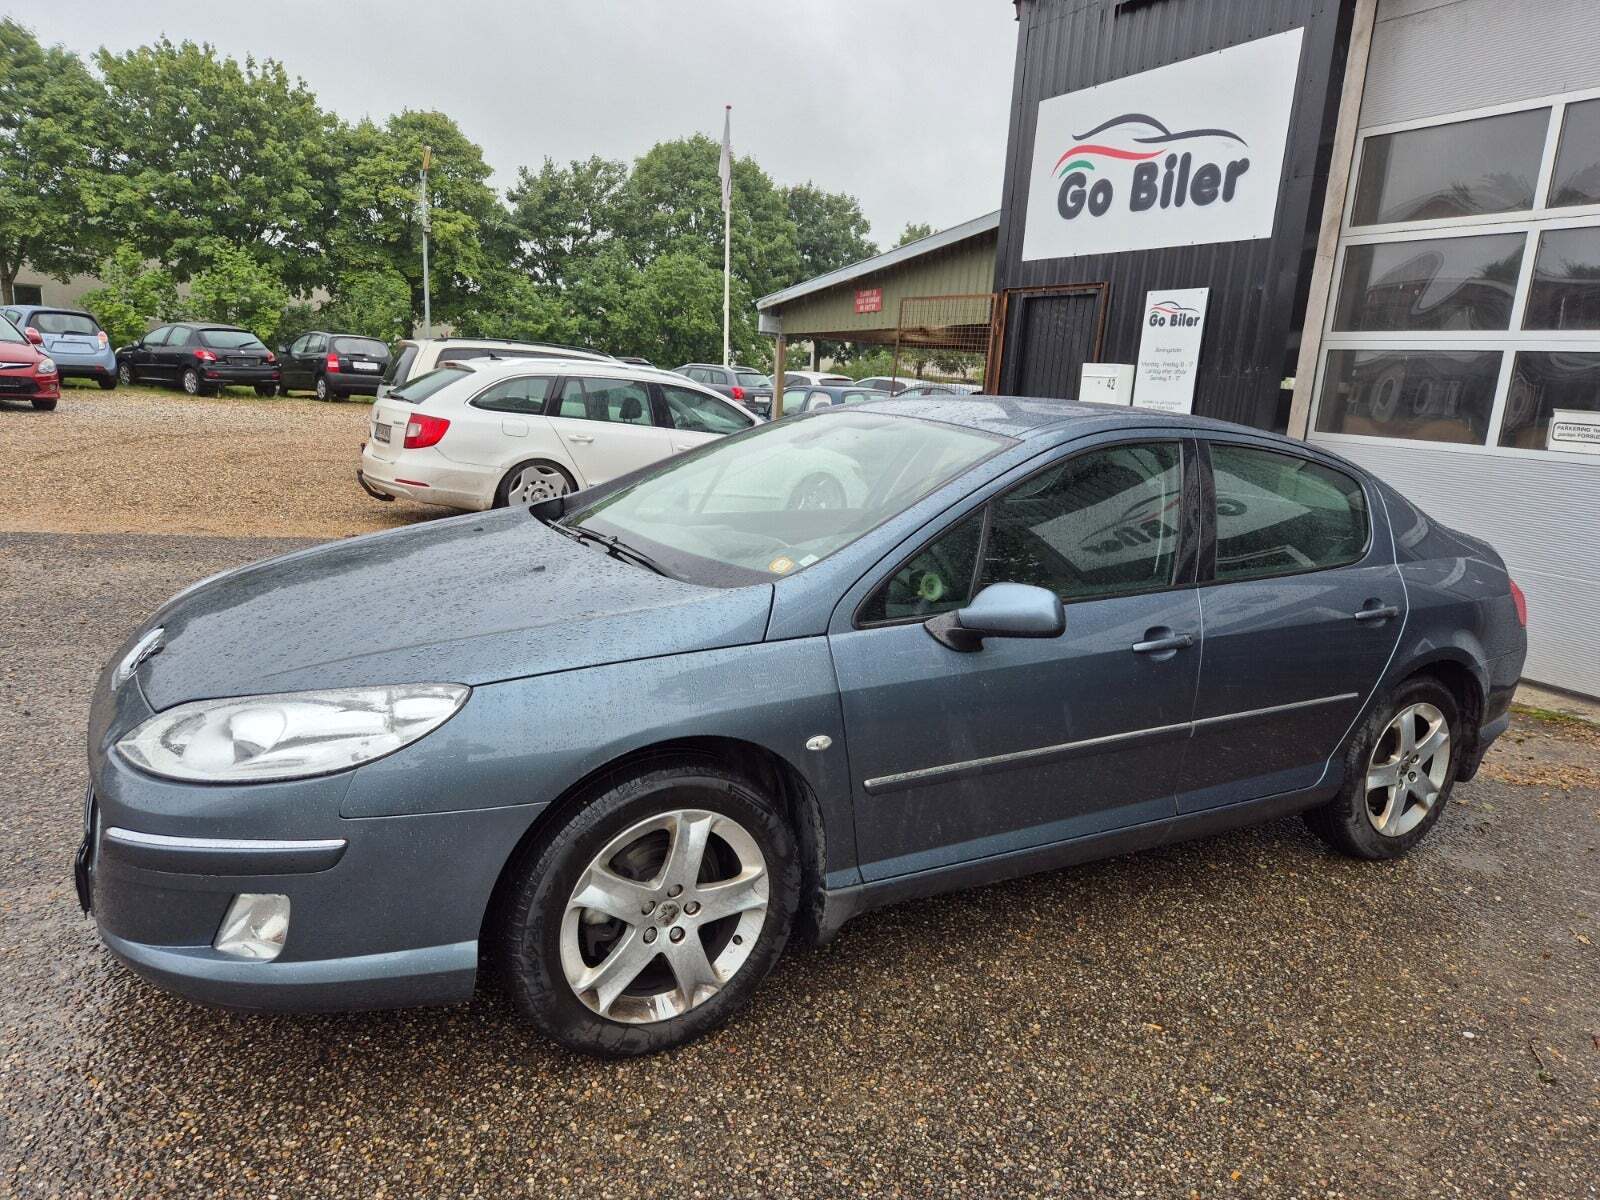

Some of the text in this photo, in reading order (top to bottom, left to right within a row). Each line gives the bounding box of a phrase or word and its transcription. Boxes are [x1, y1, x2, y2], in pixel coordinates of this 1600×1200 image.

[1057, 151, 1250, 220] Go Biler
[1150, 313, 1200, 327] Go Biler
[1106, 378, 1116, 390] 42
